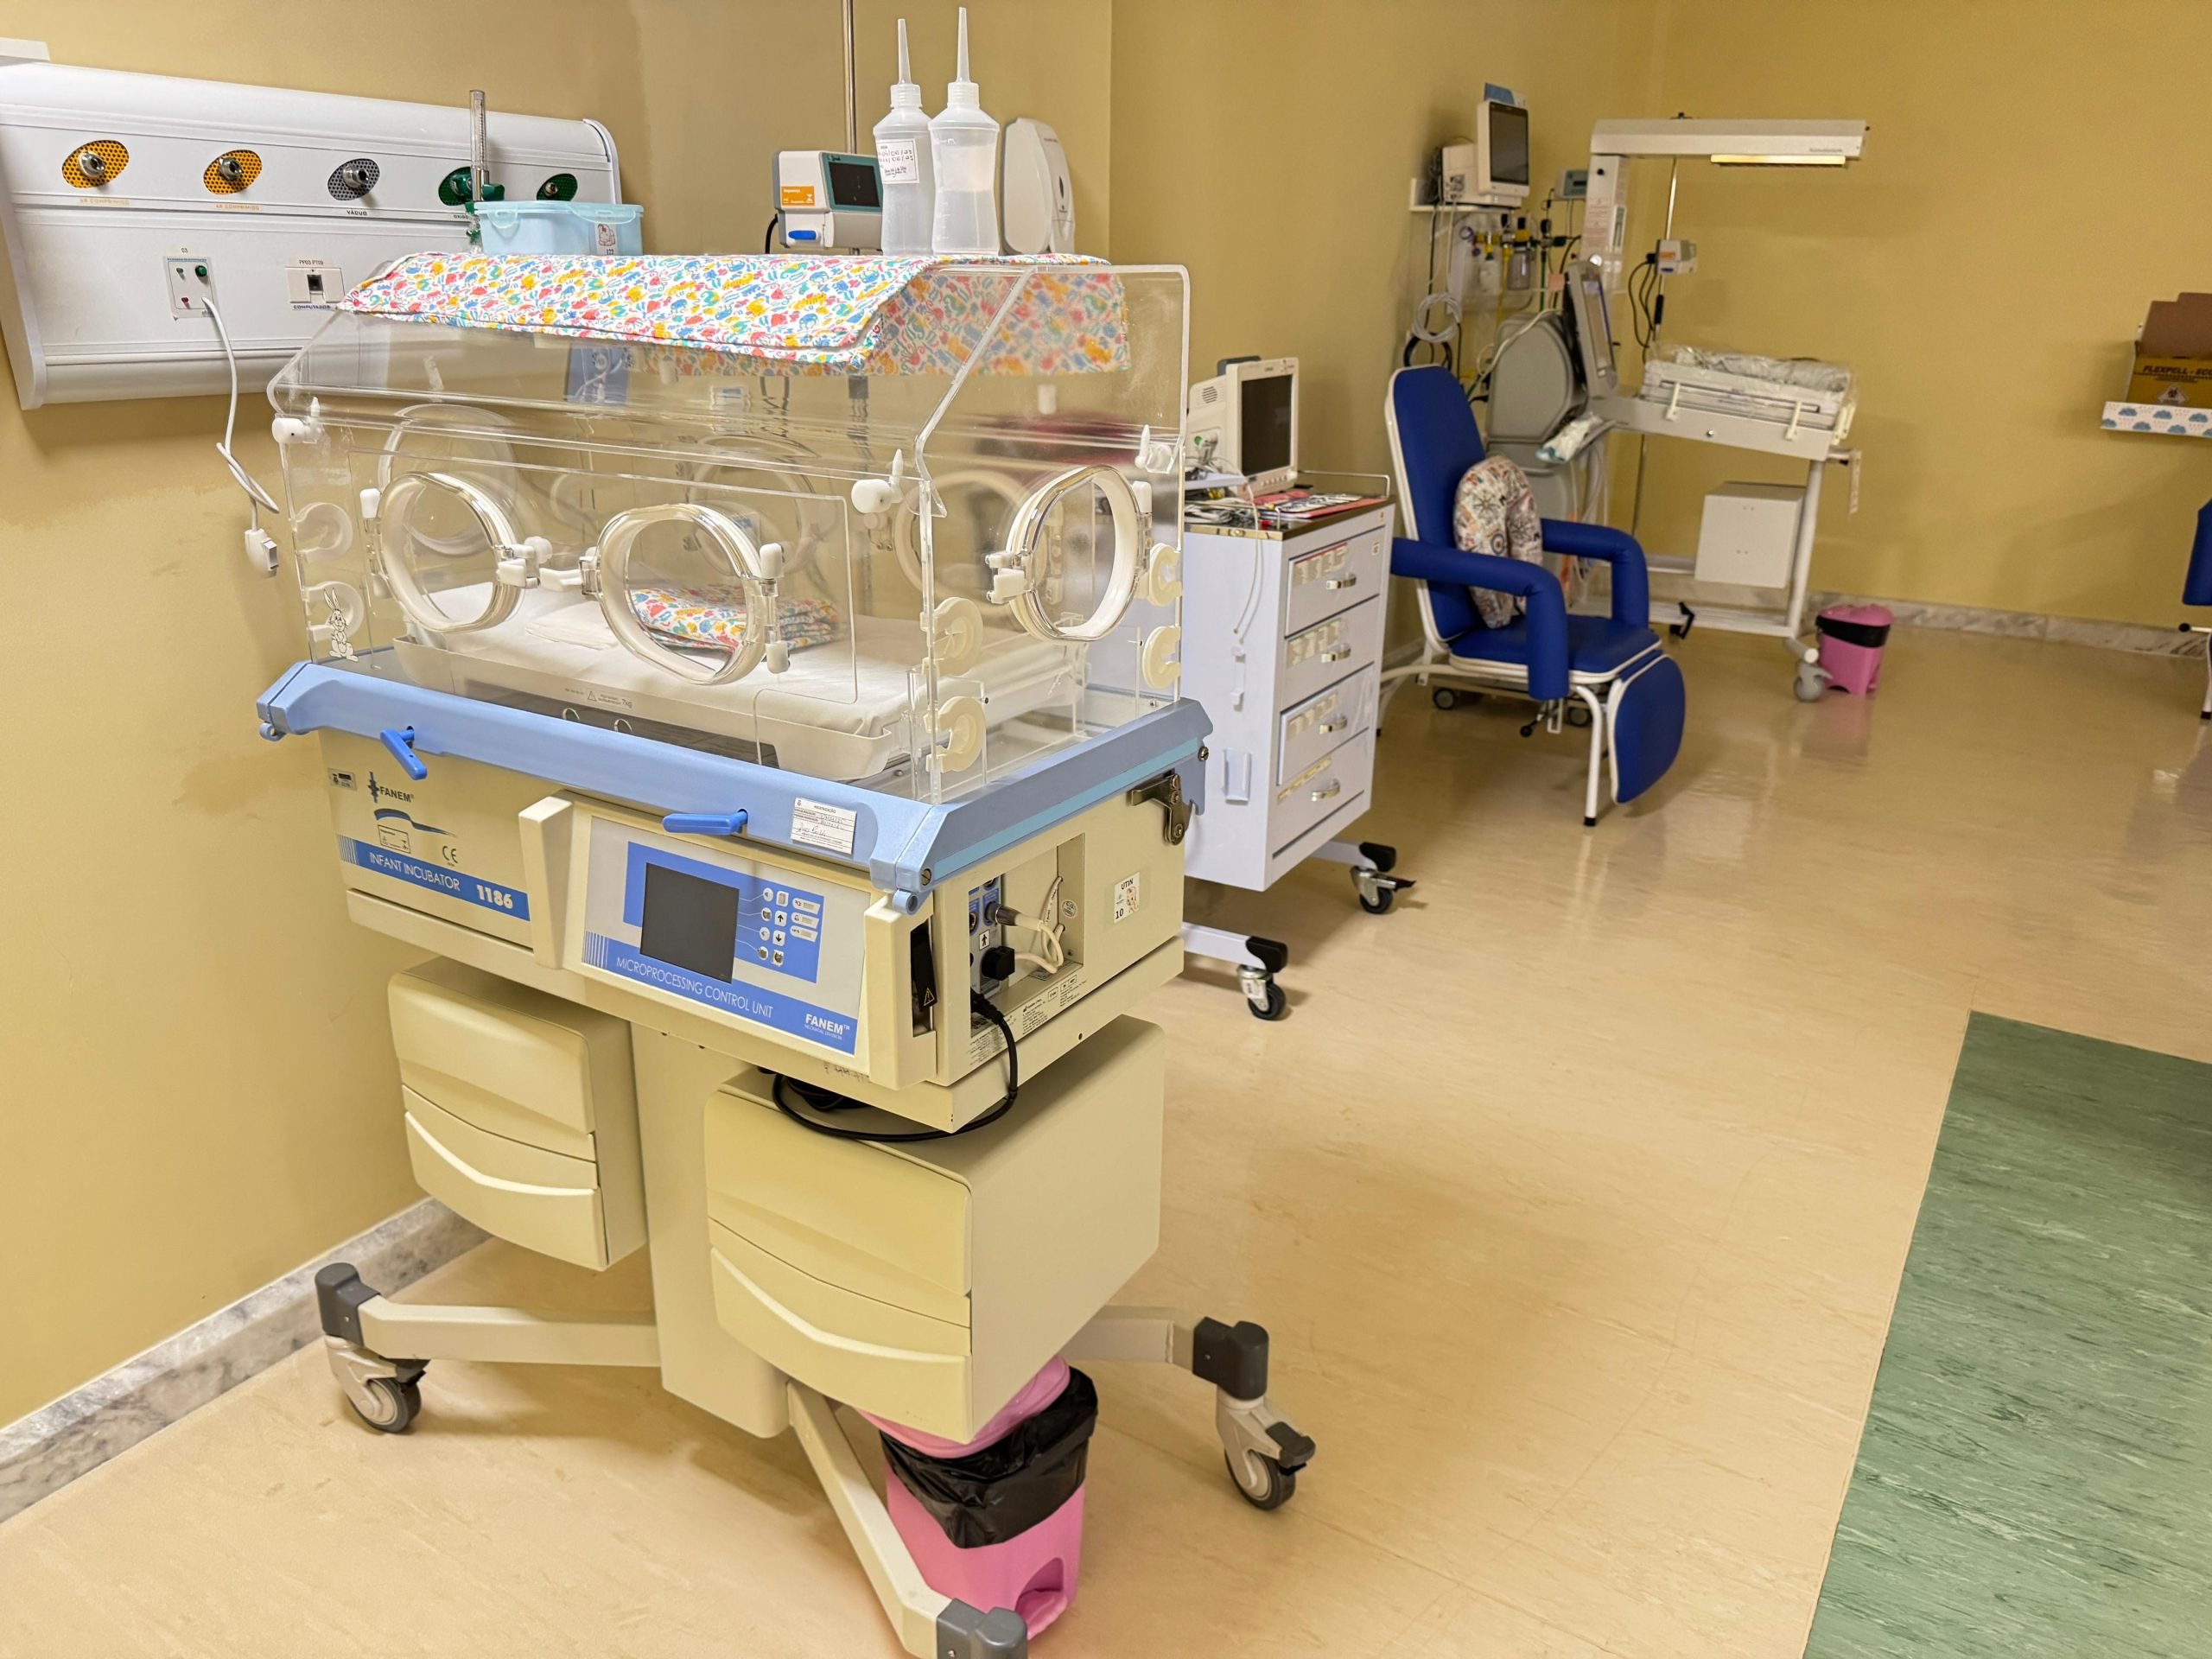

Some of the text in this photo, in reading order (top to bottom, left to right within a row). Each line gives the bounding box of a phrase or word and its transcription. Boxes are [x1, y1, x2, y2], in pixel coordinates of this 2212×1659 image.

[369, 852, 513, 909] INFANT INCUBATOR 1186
[1121, 878, 1134, 890] UTIN
[1116, 908, 1124, 919] 10
[616, 957, 773, 1019] MICROPROCESSING CONTROL UNIT
